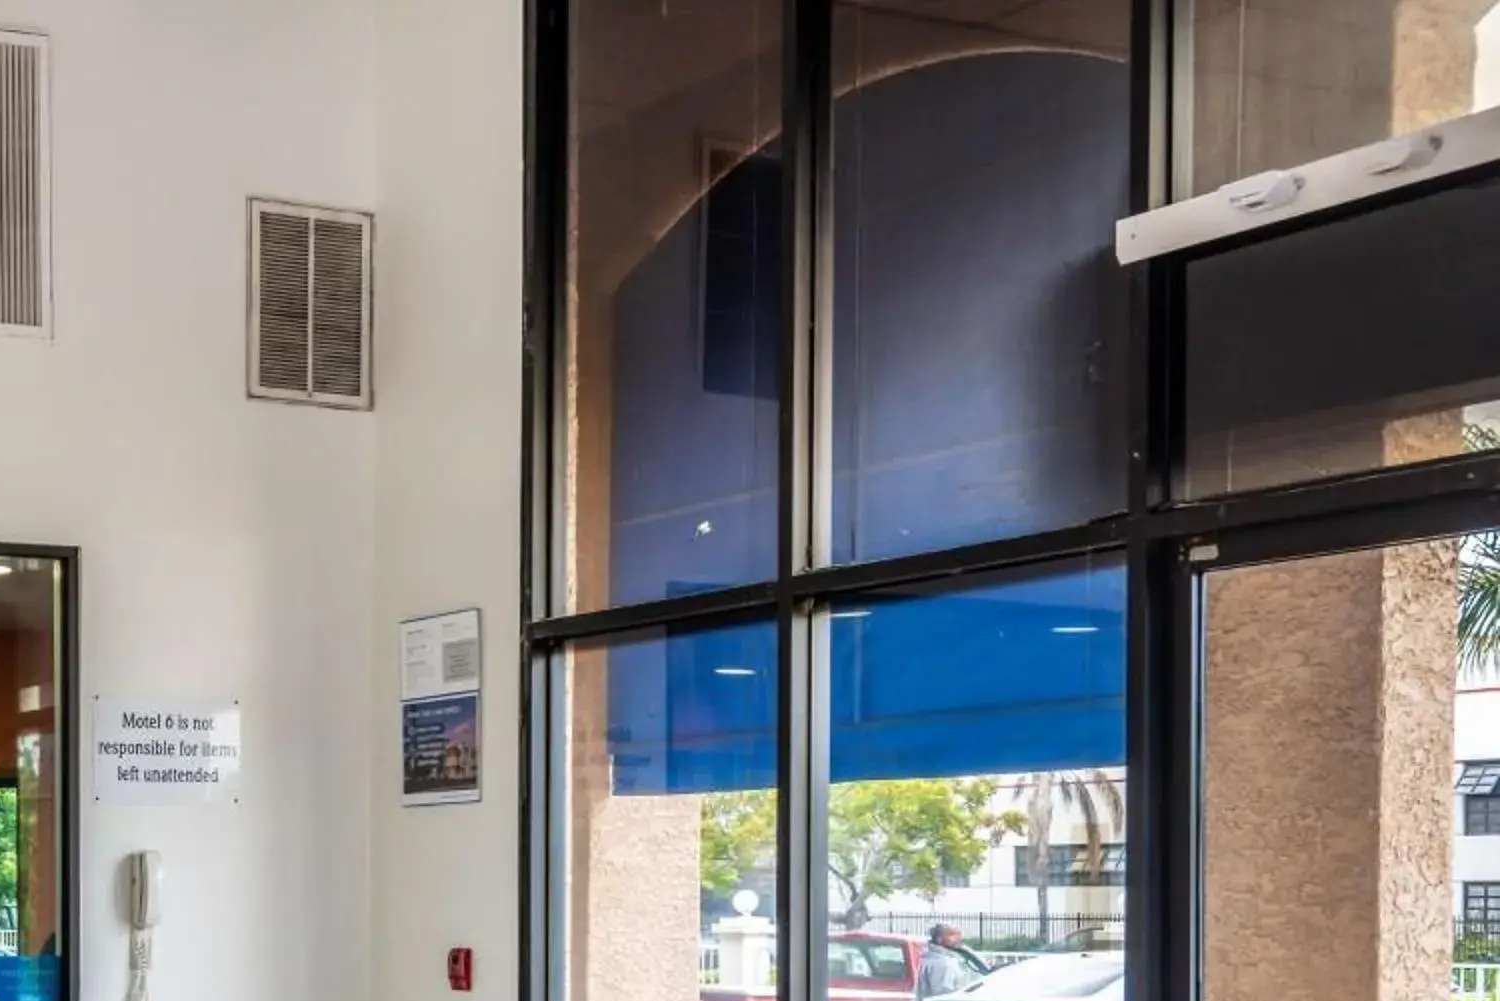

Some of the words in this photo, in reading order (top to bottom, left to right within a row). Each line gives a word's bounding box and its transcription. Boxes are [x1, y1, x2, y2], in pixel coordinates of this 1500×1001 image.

[122, 712, 161, 729] Motel
[165, 713, 174, 729] 6
[178, 714, 189, 730] is
[193, 717, 213, 731] not
[98, 740, 175, 758] responsible
[180, 741, 198, 757] for
[202, 741, 237, 757] items
[117, 766, 139, 781] left
[143, 767, 219, 782] unattended
